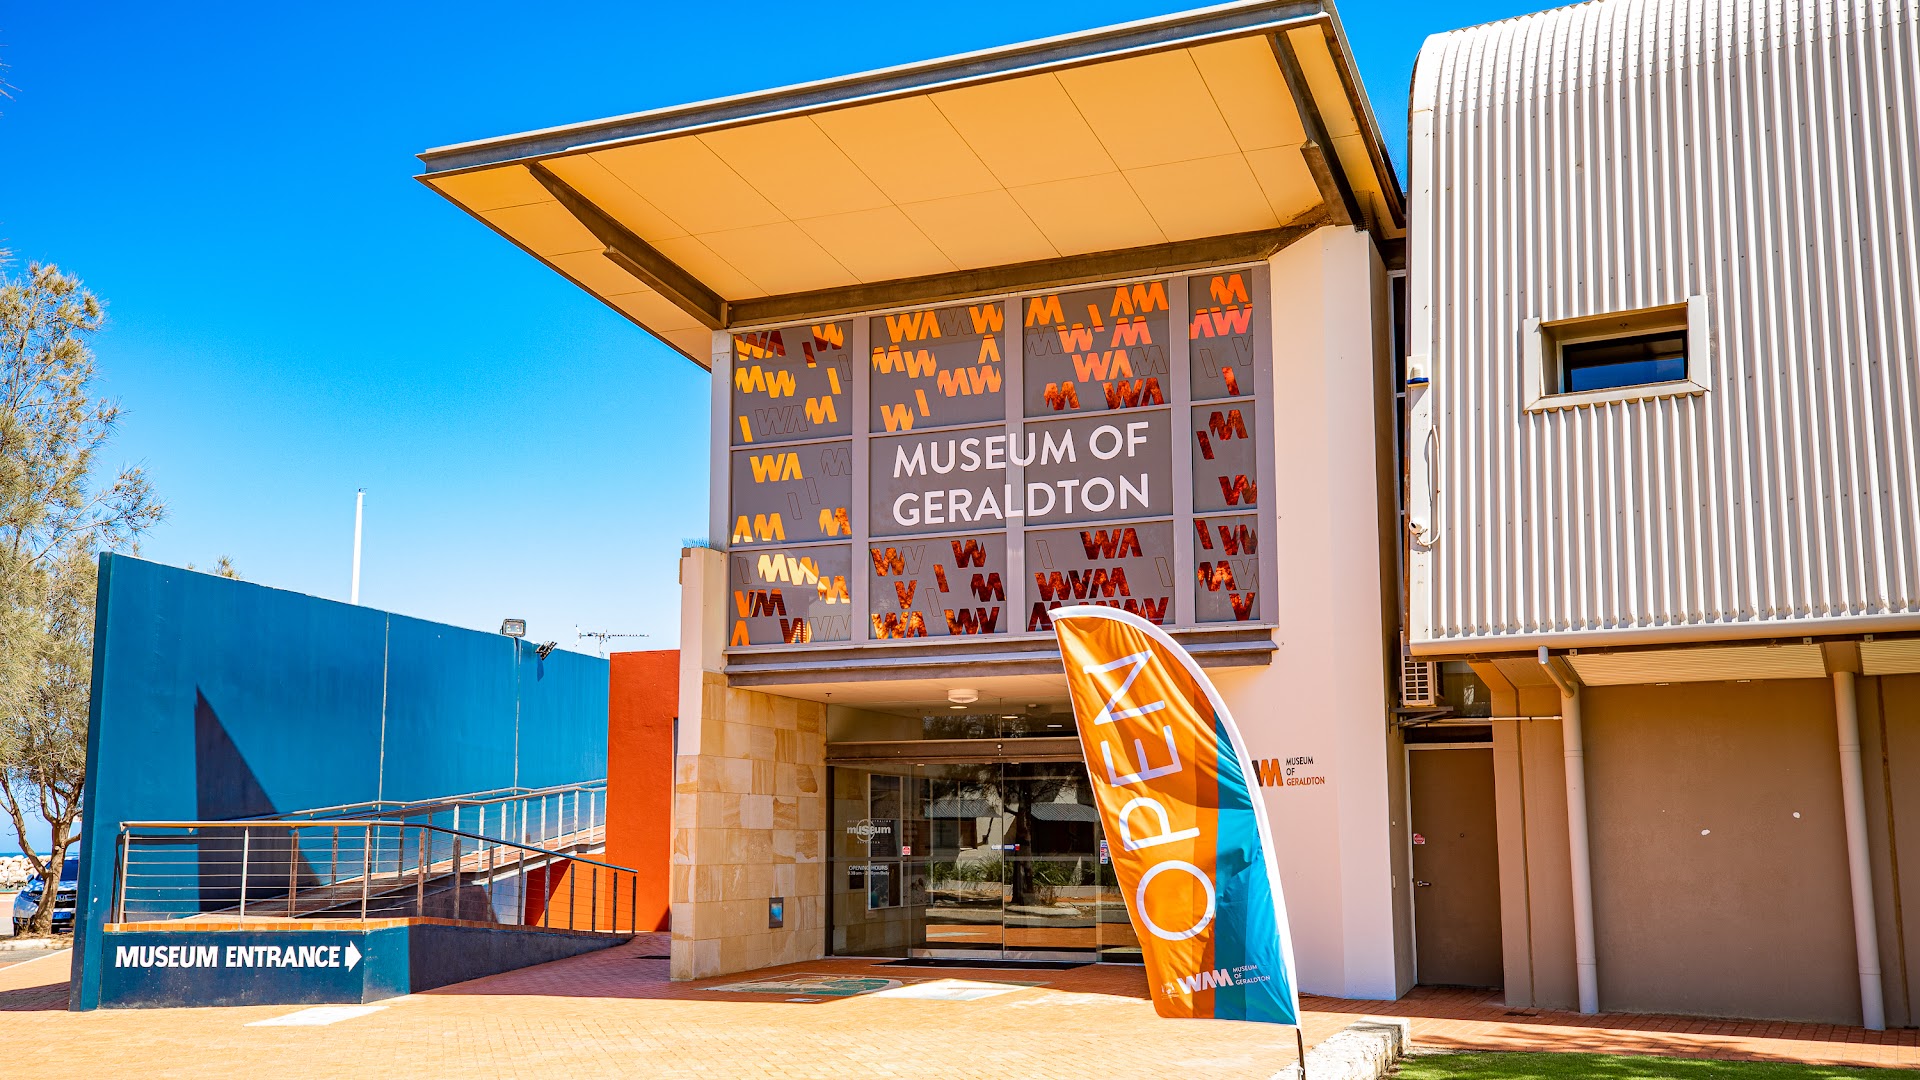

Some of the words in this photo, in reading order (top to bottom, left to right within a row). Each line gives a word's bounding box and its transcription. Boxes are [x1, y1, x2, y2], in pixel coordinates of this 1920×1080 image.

[893, 428, 1077, 478] MUSEUM
[1089, 421, 1149, 460] OF
[893, 473, 1149, 527] GERALDTON
[1286, 756, 1314, 766] MUSEUM
[1286, 768, 1295, 776] OF
[1286, 777, 1325, 786] GERALDTON
[1083, 649, 1216, 941] OPEN
[847, 825, 891, 836] museum
[115, 945, 218, 968] MUSEUM
[225, 945, 341, 968] ENTRANCE
[1232, 965, 1258, 973] MUSEUM
[1176, 968, 1234, 995] WAM
[1235, 975, 1271, 985] GERALDTON
